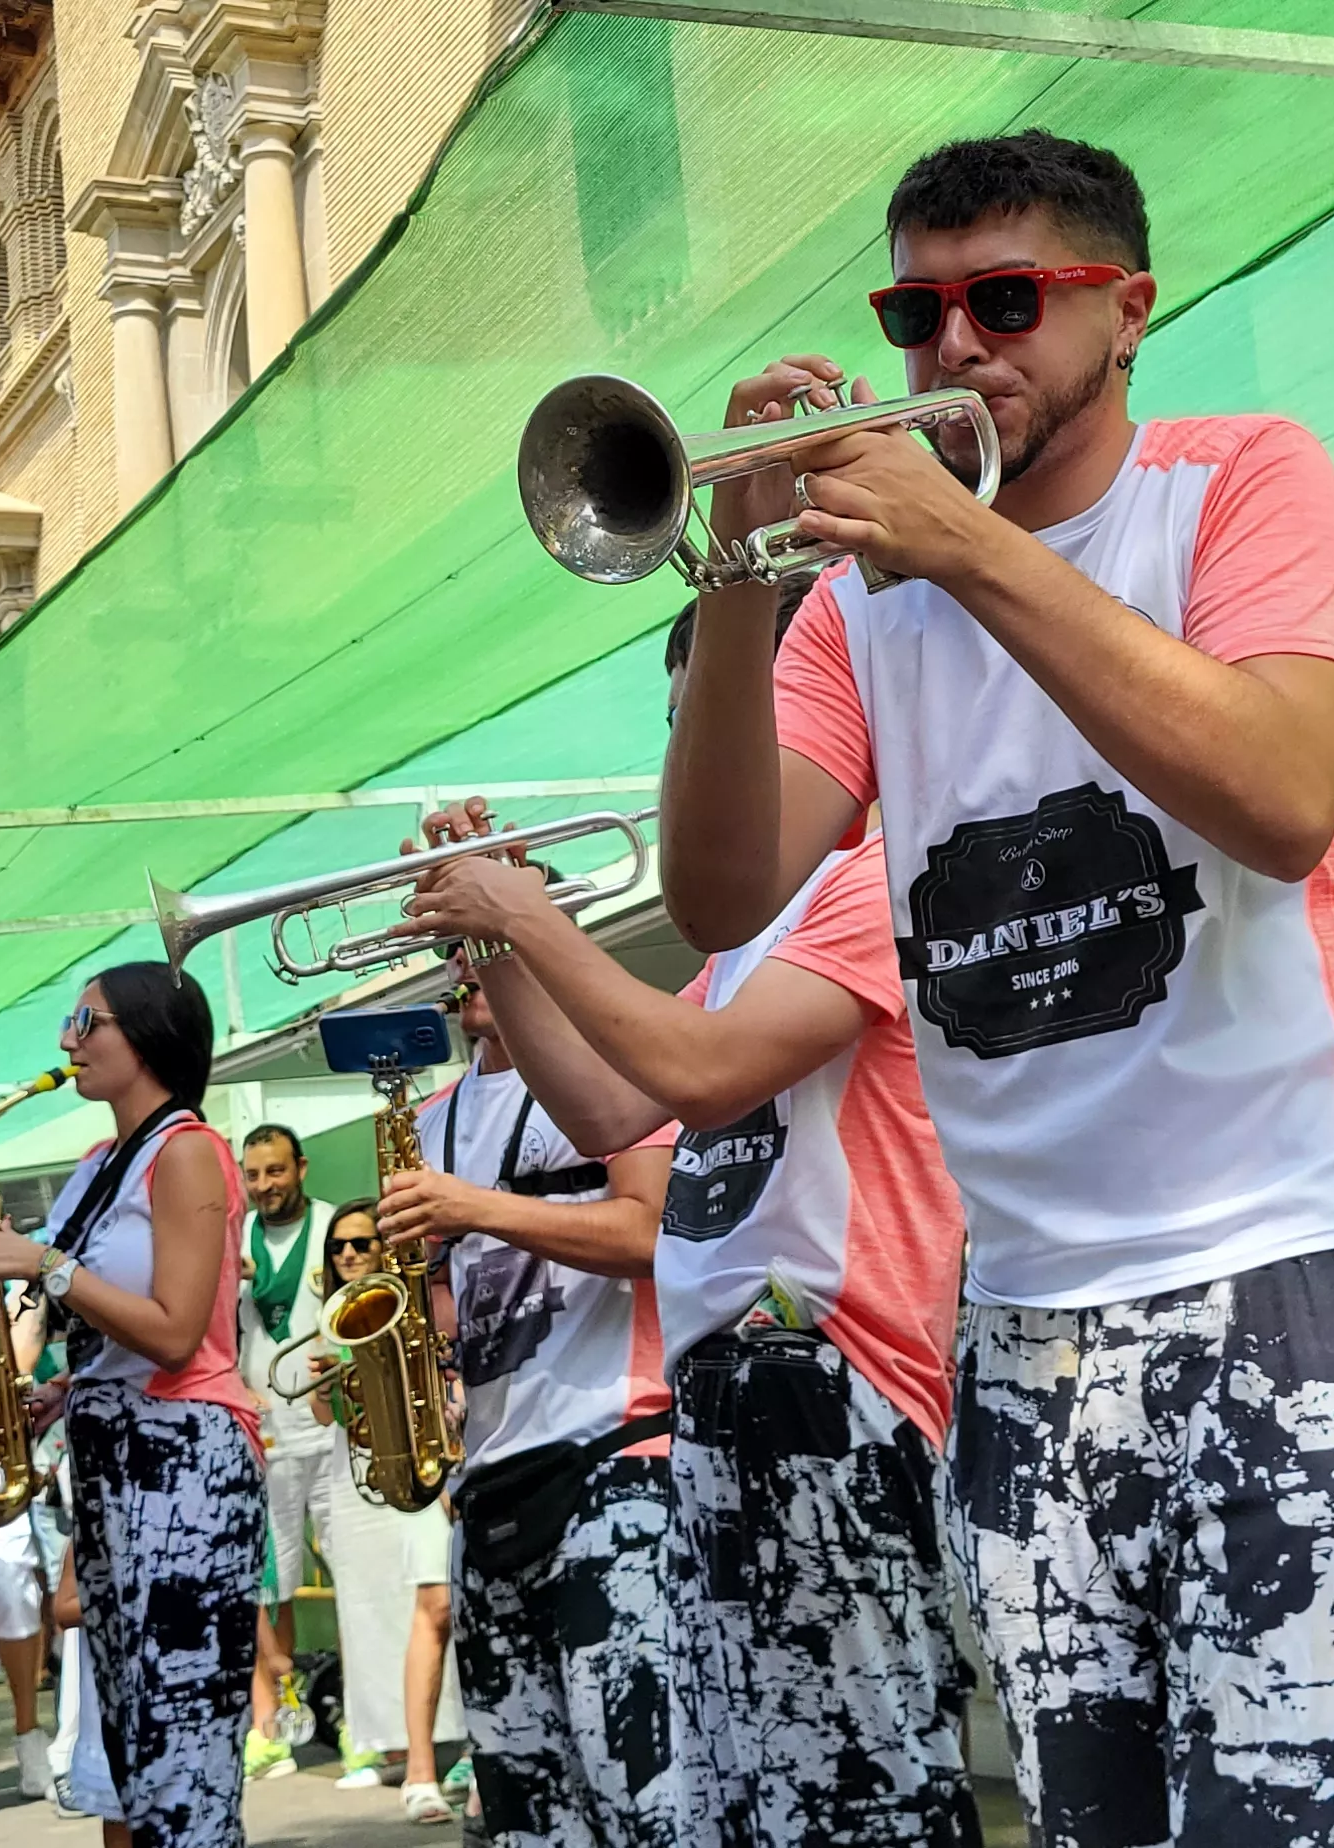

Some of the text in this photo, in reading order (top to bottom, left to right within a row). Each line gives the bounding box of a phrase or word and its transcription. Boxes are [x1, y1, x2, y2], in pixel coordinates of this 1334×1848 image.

[1038, 827, 1073, 842] Shop
[927, 882, 1165, 972] DANIEL'S
[1011, 957, 1080, 991] SINCE 2016
